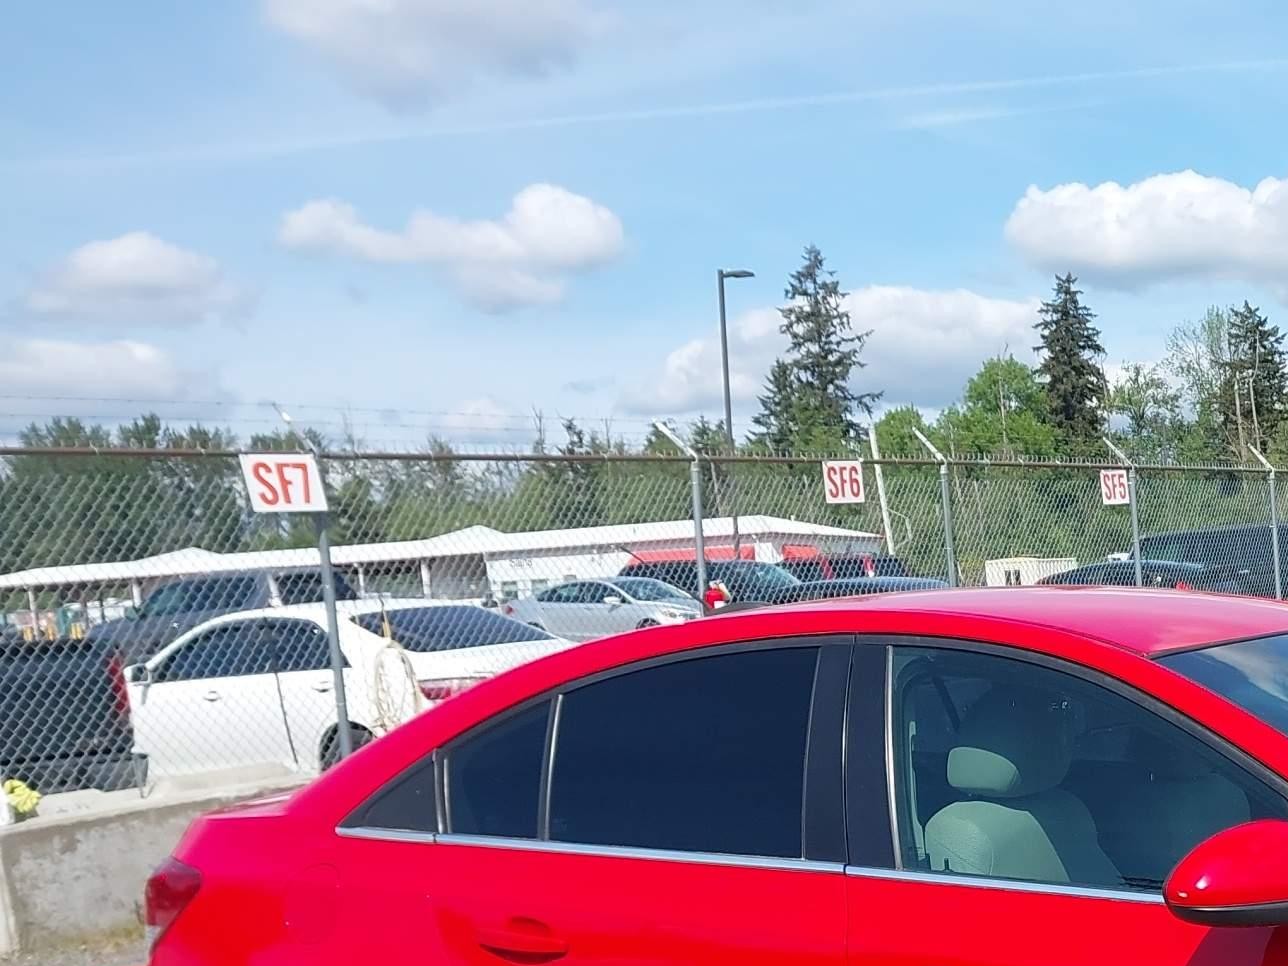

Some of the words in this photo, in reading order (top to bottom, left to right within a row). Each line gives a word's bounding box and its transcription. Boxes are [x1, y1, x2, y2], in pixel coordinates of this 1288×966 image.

[253, 462, 310, 505] SF7
[827, 466, 860, 498] SF6
[1103, 473, 1126, 500] SF5
